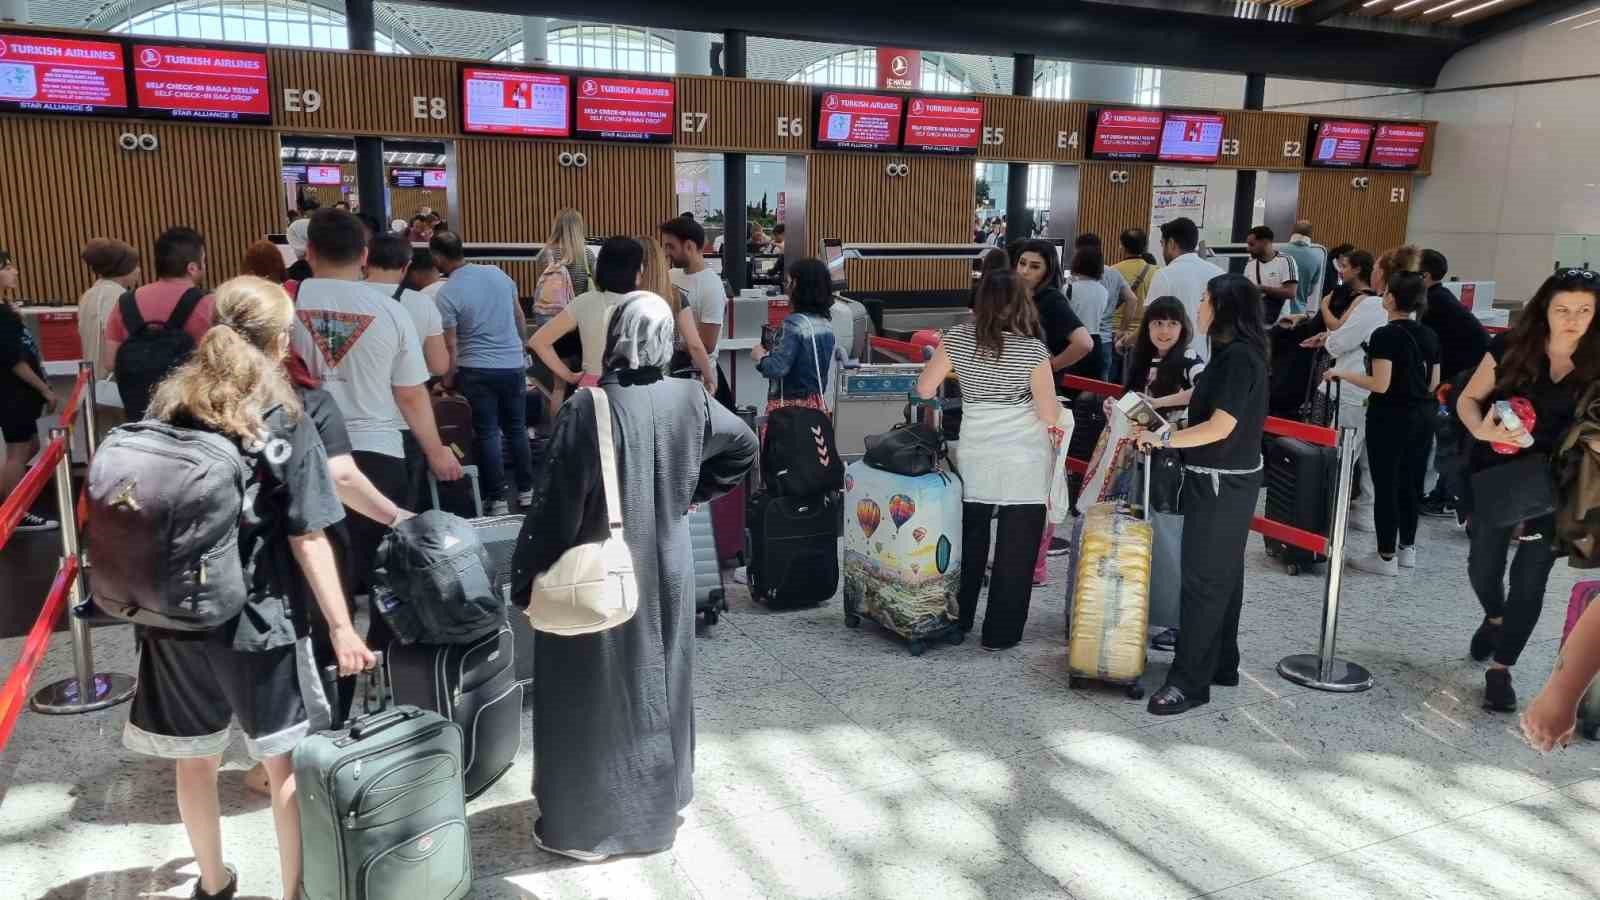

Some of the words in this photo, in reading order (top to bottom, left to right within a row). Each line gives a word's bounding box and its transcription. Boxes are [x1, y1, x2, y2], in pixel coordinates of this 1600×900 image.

[10, 44, 62, 56] TURKISH
[64, 48, 115, 60] AIRLINES
[165, 55, 210, 65] TURKISH
[214, 58, 260, 69] AIRLINES
[166, 83, 204, 91] CHECK-IN
[600, 85, 634, 94] TURKISH
[635, 87, 669, 97] AIRLINES
[175, 91, 211, 99] CHECK-IN
[231, 94, 253, 102] DROP
[284, 88, 321, 113] E9
[20, 102, 41, 110] STAR
[43, 104, 84, 112] ALLIANCE
[413, 96, 447, 120] E8
[841, 100, 868, 108] TURKISH
[869, 102, 898, 110] AIRLINES
[681, 112, 708, 132] E7
[777, 116, 803, 137] E6
[982, 127, 1004, 145] E5
[1057, 130, 1079, 149] E4
[1221, 138, 1240, 155] E3
[1283, 141, 1301, 157] E2
[1390, 188, 1405, 203] E1
